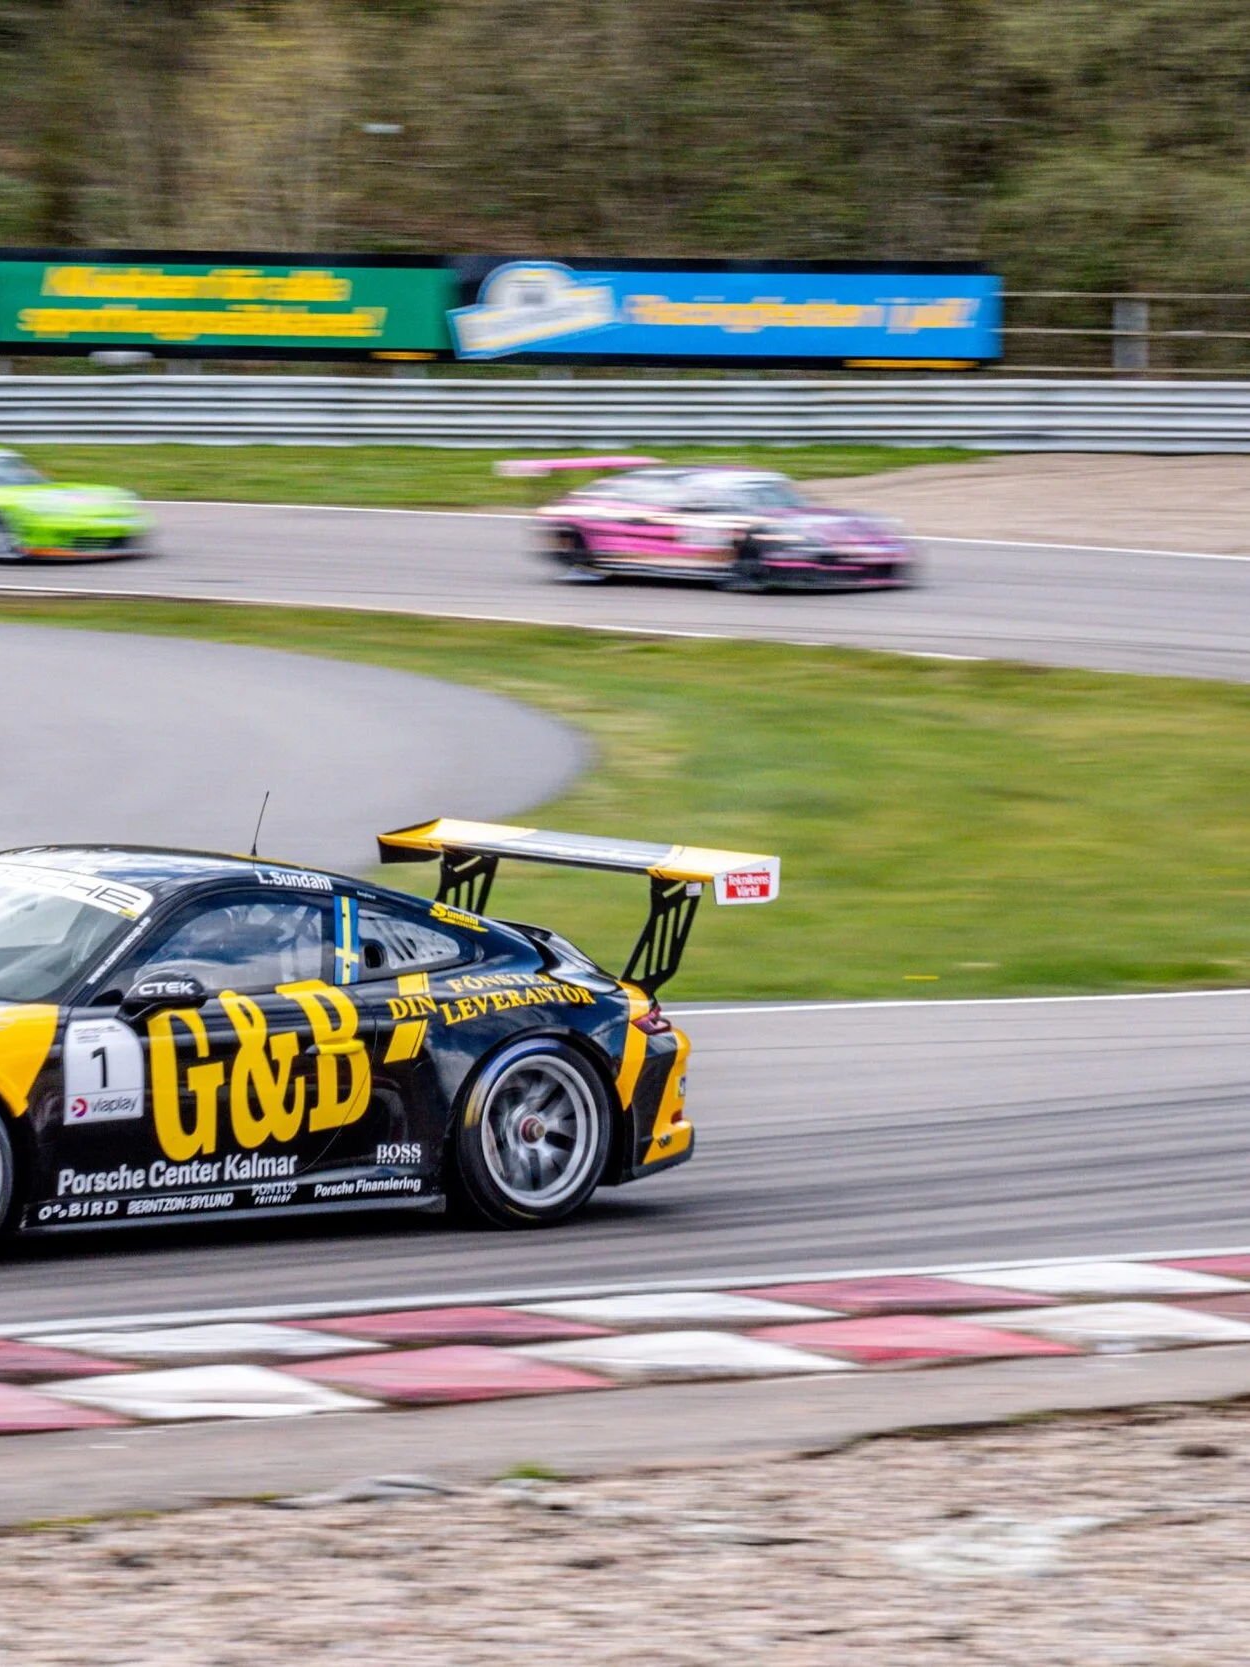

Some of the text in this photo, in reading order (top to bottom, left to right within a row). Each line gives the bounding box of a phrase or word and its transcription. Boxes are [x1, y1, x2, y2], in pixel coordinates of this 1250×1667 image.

[255, 870, 333, 891] L.Sundahl
[430, 901, 479, 926] Sundahl
[139, 981, 195, 996] CTEK
[386, 993, 438, 1020] DIN
[440, 983, 596, 1026] LEVERANTÖR
[90, 1046, 108, 1089] 1
[147, 979, 372, 1162] G&B
[91, 1096, 138, 1113] viaplay
[376, 1143, 421, 1159] BOSS
[57, 1152, 298, 1196] Porsche Center Kalmar
[251, 1181, 297, 1196] PONTUS
[314, 1176, 422, 1198] Porsche Finansiering
